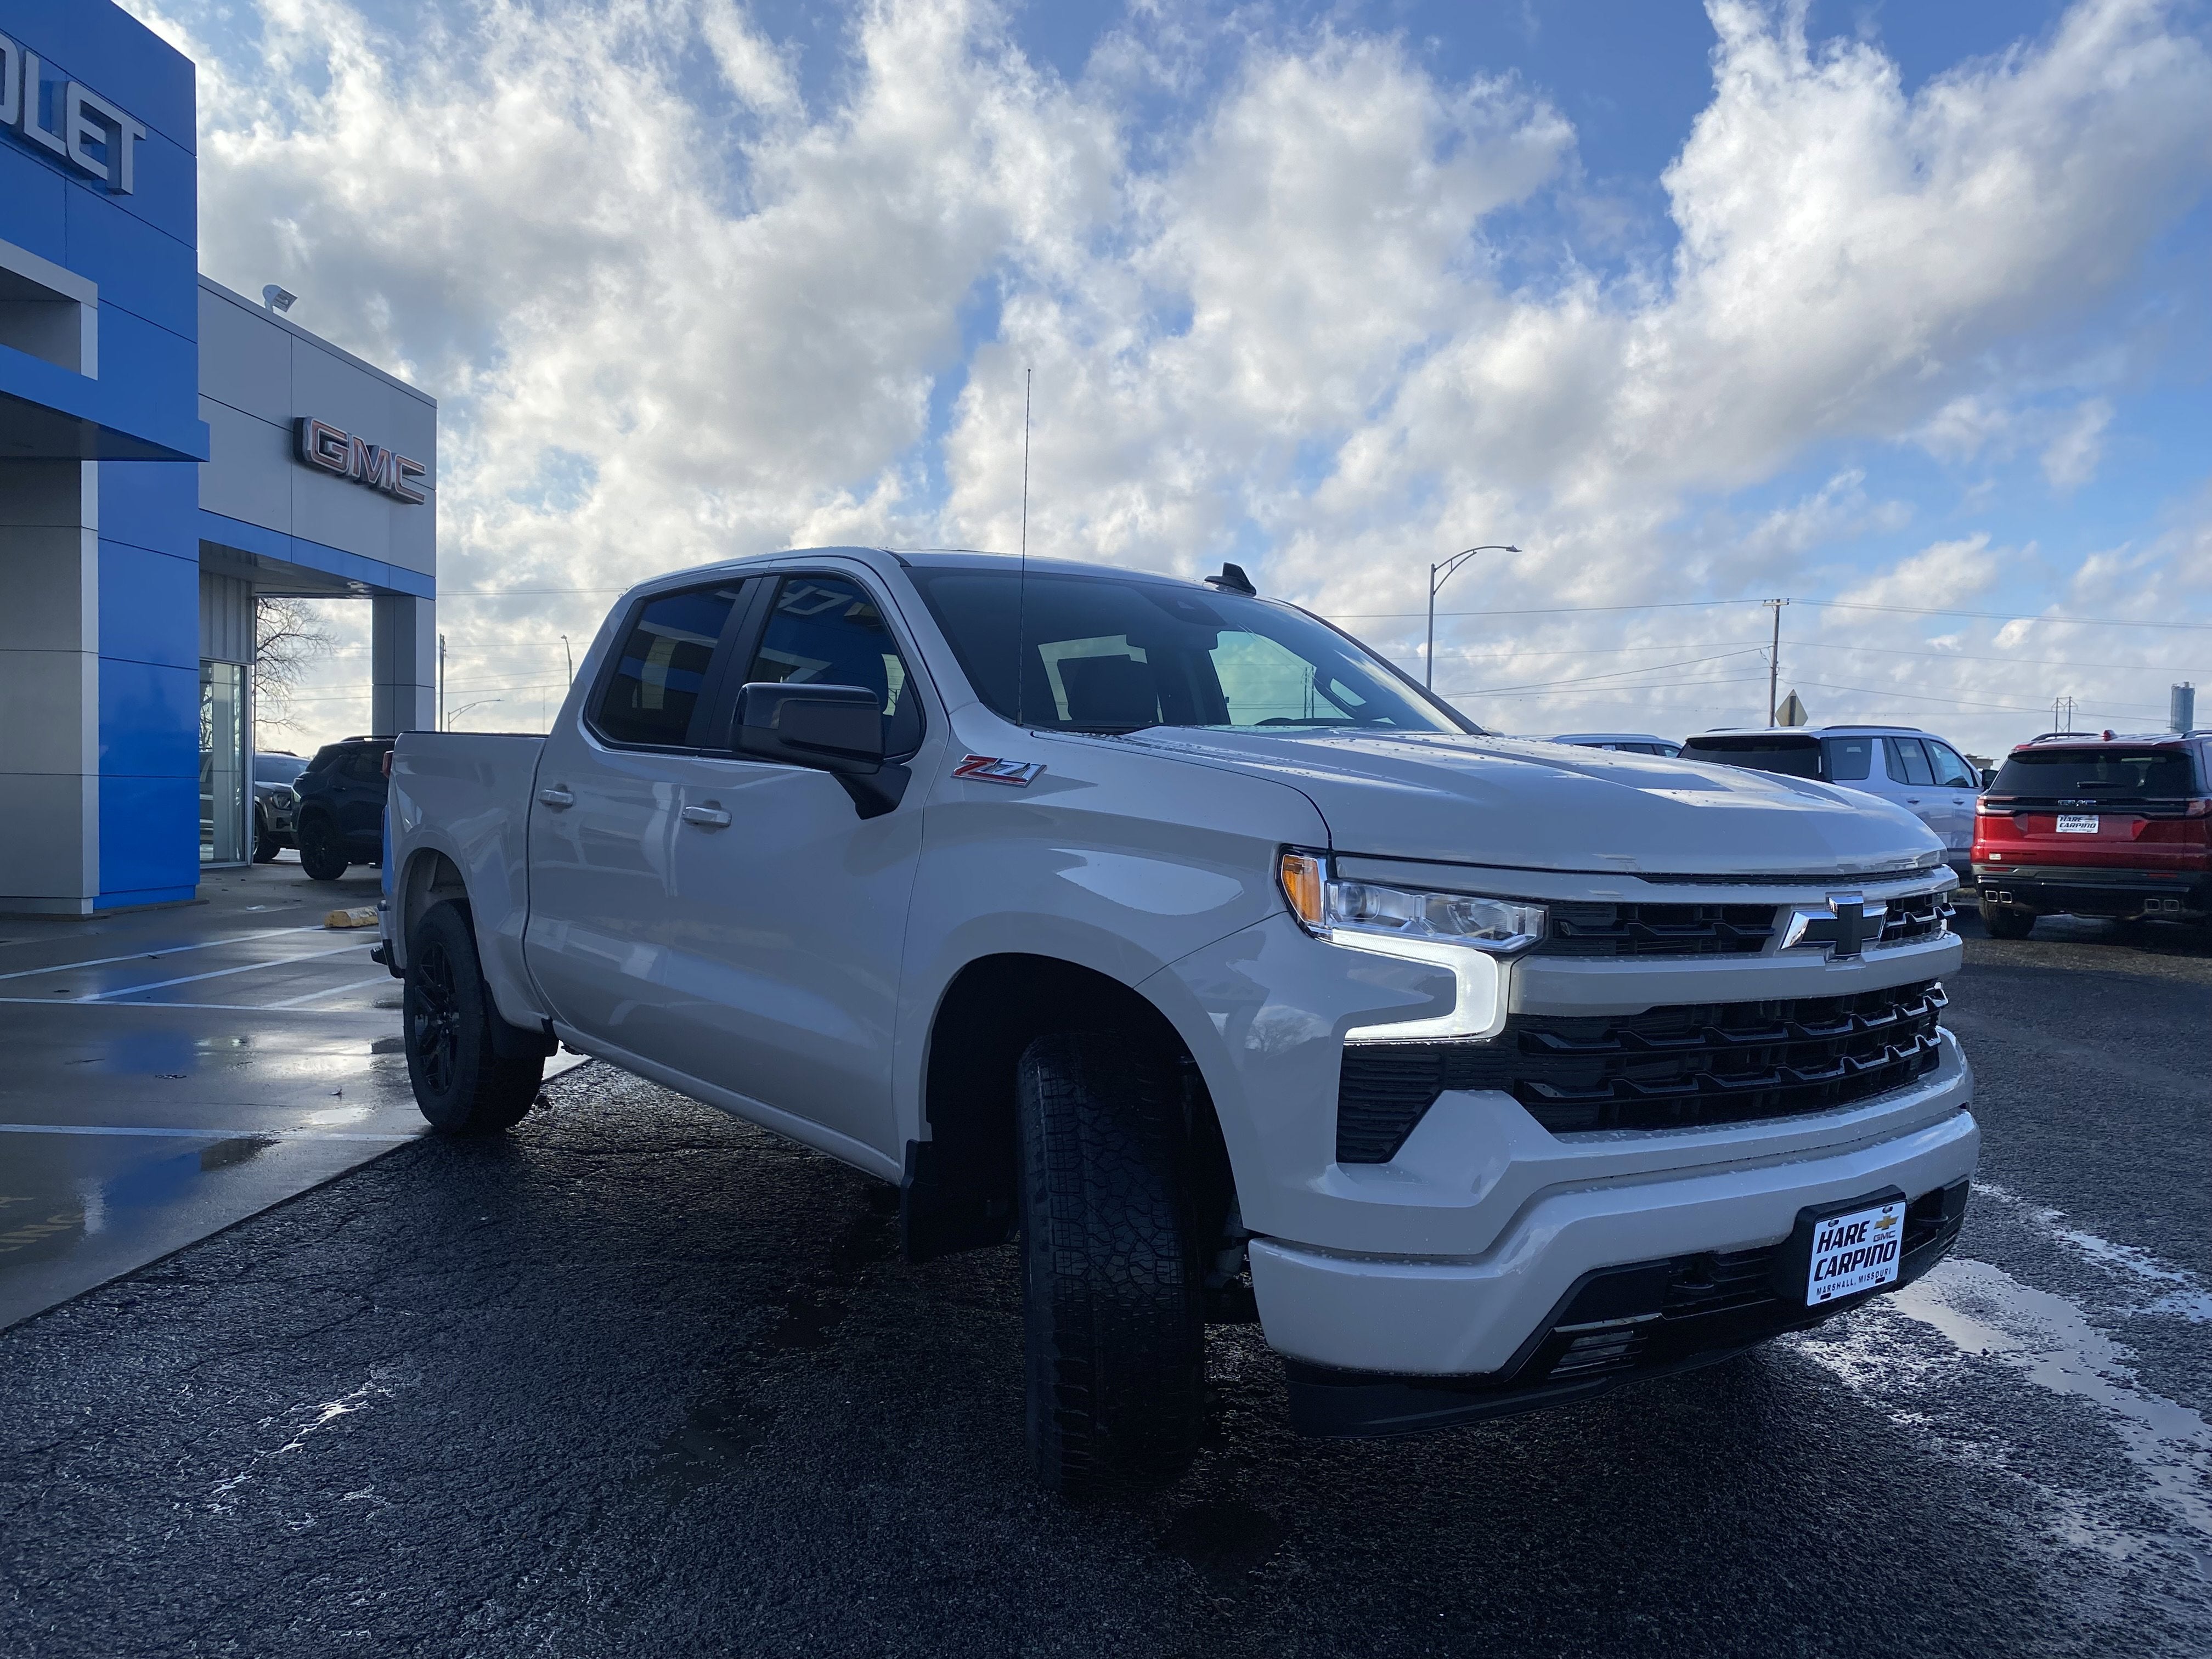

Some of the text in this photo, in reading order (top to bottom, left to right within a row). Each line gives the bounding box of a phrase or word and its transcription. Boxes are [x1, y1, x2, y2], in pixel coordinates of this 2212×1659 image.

[299, 416, 426, 505] GMC
[951, 754, 1047, 788] Z71
[1816, 1220, 1870, 1254] HARE
[1874, 1230, 1896, 1242] GMC
[1814, 1239, 1898, 1282] CARPINO
[1859, 1267, 1891, 1283] MISSOURI
